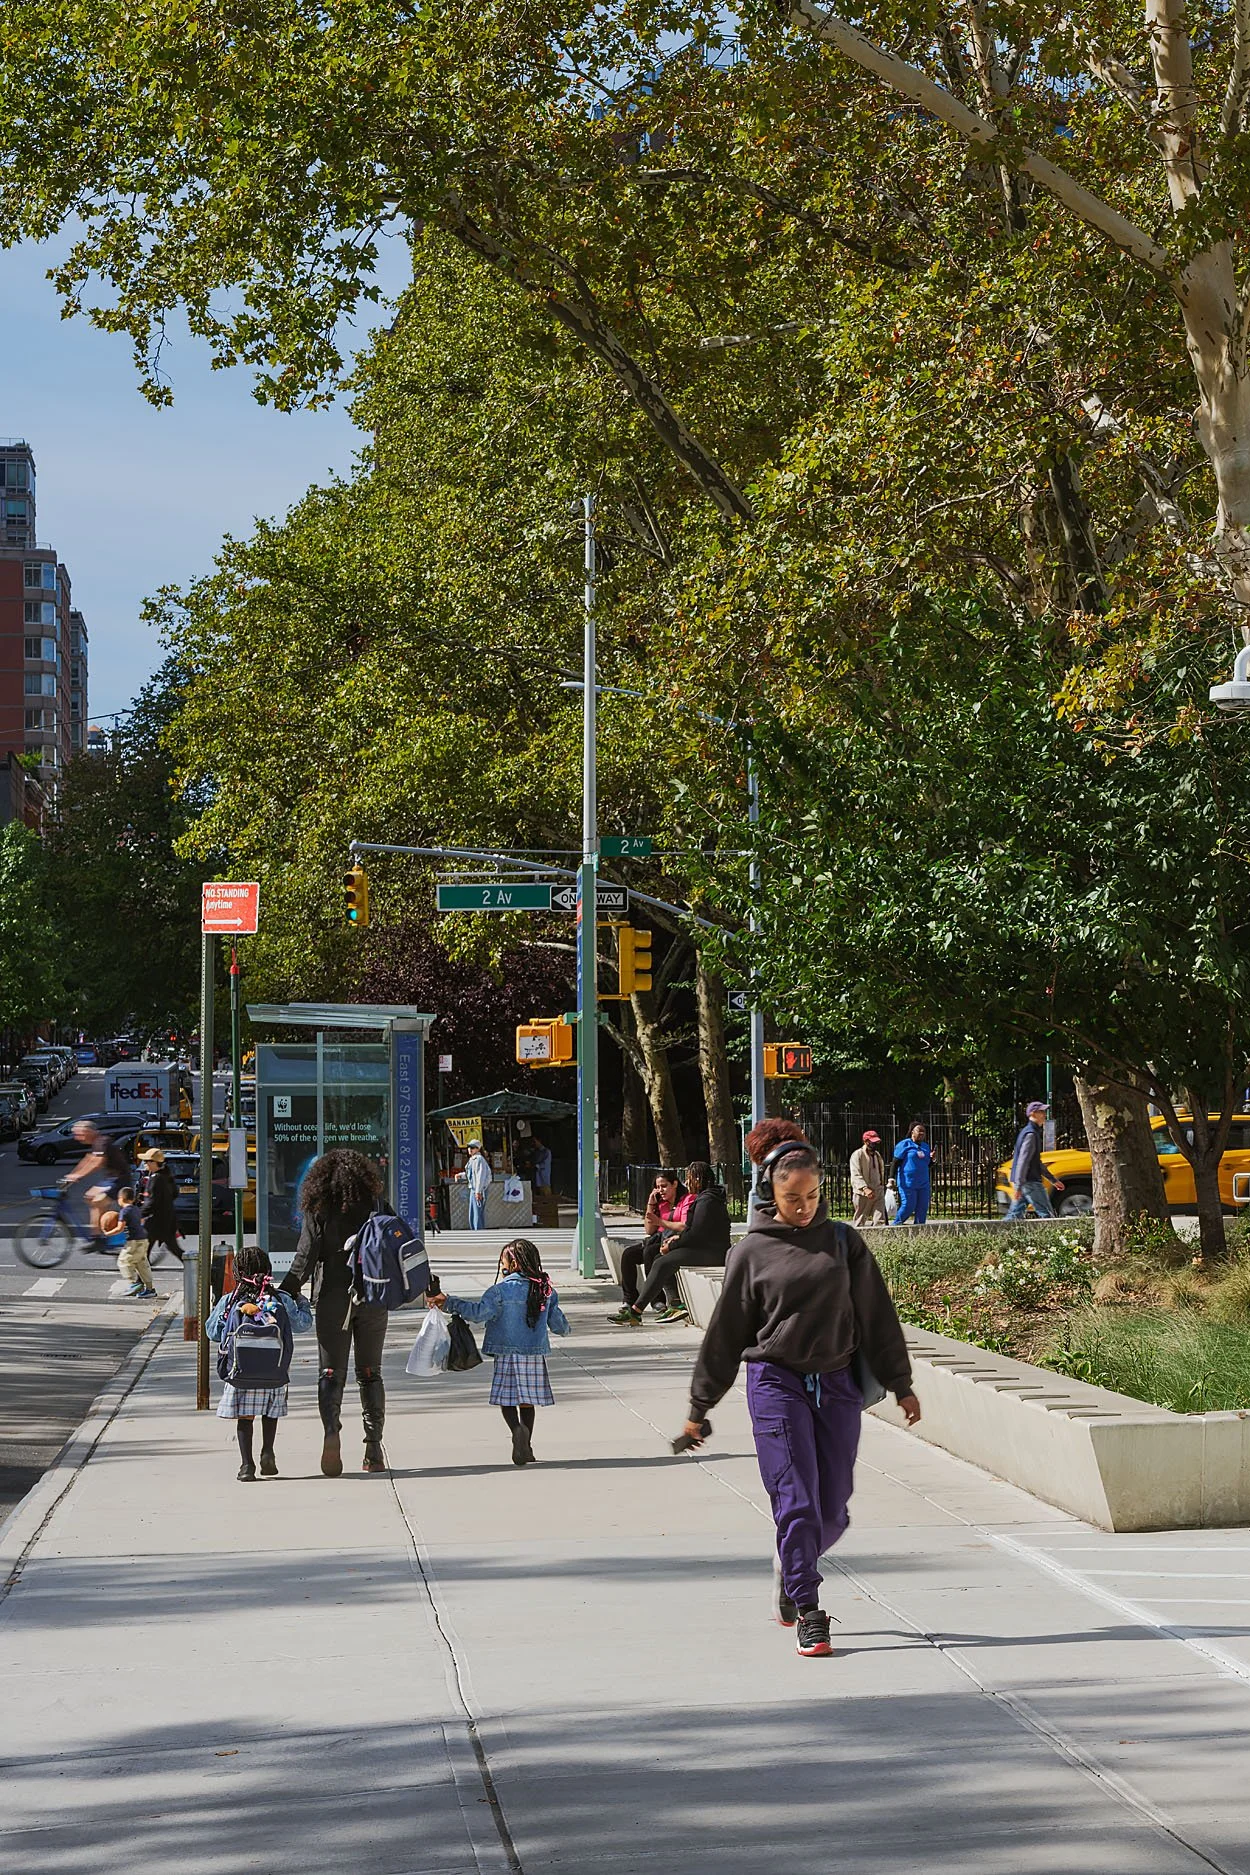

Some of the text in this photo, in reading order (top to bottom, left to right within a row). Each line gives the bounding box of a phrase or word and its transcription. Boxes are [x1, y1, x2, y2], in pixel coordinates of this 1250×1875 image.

[620, 840, 630, 854] 2
[216, 888, 249, 898] STANDING
[482, 890, 512, 905] 2 Av
[561, 893, 621, 904] ON WAY
[399, 1054, 410, 1082] East
[110, 1083, 164, 1100] FedEx
[399, 1087, 411, 1101] 97
[274, 1122, 302, 1131] Without
[357, 1122, 372, 1131] lose
[399, 1105, 411, 1142] Street
[447, 1119, 479, 1127] BANANAS
[274, 1134, 290, 1142] 50%
[290, 1133, 299, 1142] of
[299, 1133, 311, 1142] the
[350, 1133, 379, 1142] breathe.
[400, 1169, 411, 1217] Avenue
